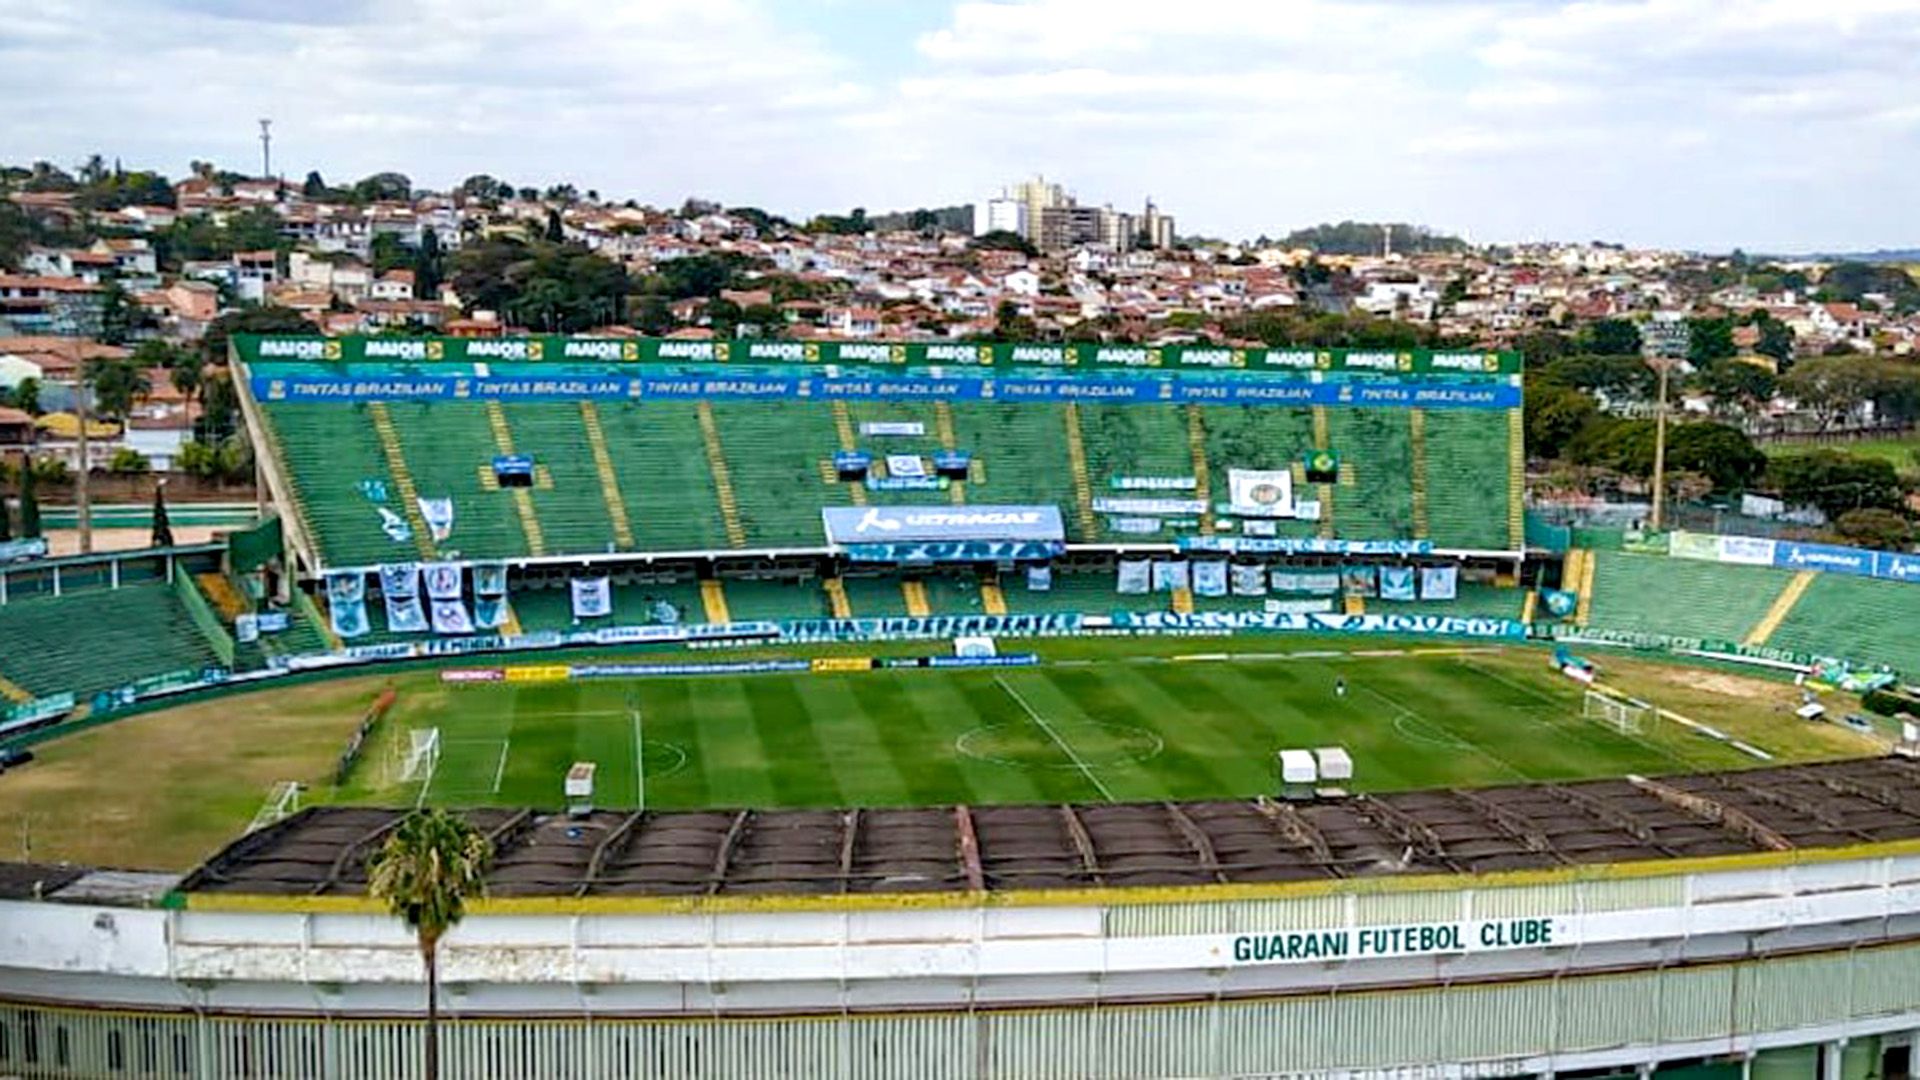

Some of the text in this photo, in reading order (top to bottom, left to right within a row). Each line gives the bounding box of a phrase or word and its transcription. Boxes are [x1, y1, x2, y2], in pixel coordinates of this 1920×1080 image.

[260, 340, 323, 355] MAIOR
[365, 341, 425, 356] MAIOR
[467, 341, 526, 356] MAIOR
[565, 342, 620, 356] MAIOR
[658, 343, 711, 357] MAIOR
[750, 344, 802, 357] MAIOR
[839, 345, 890, 358] MAIOR
[926, 346, 977, 359] MAIOR
[1012, 347, 1062, 360] MAIOR
[1096, 348, 1146, 361] MAIOR
[1181, 350, 1230, 363] MAIOR
[1265, 352, 1315, 365] MAIOR
[1345, 353, 1396, 366] MAIOR
[1432, 354, 1482, 367] MAIOR
[293, 383, 445, 396] TINTAS BRAZILIAN
[476, 383, 621, 394] TINTAS BRAZILIAN
[649, 382, 787, 394] TINTAS BRAZILIAN
[823, 384, 958, 394] TINTAS BRAZILIAN
[1004, 385, 1136, 396] TINTAS BRAZILIAN
[1181, 387, 1313, 399] TINTAS BRAZILIAN
[1361, 389, 1495, 402] TINTAS BRAZILIAN
[1234, 918, 1553, 961] GUARANI FUTEBOL CLUBE
